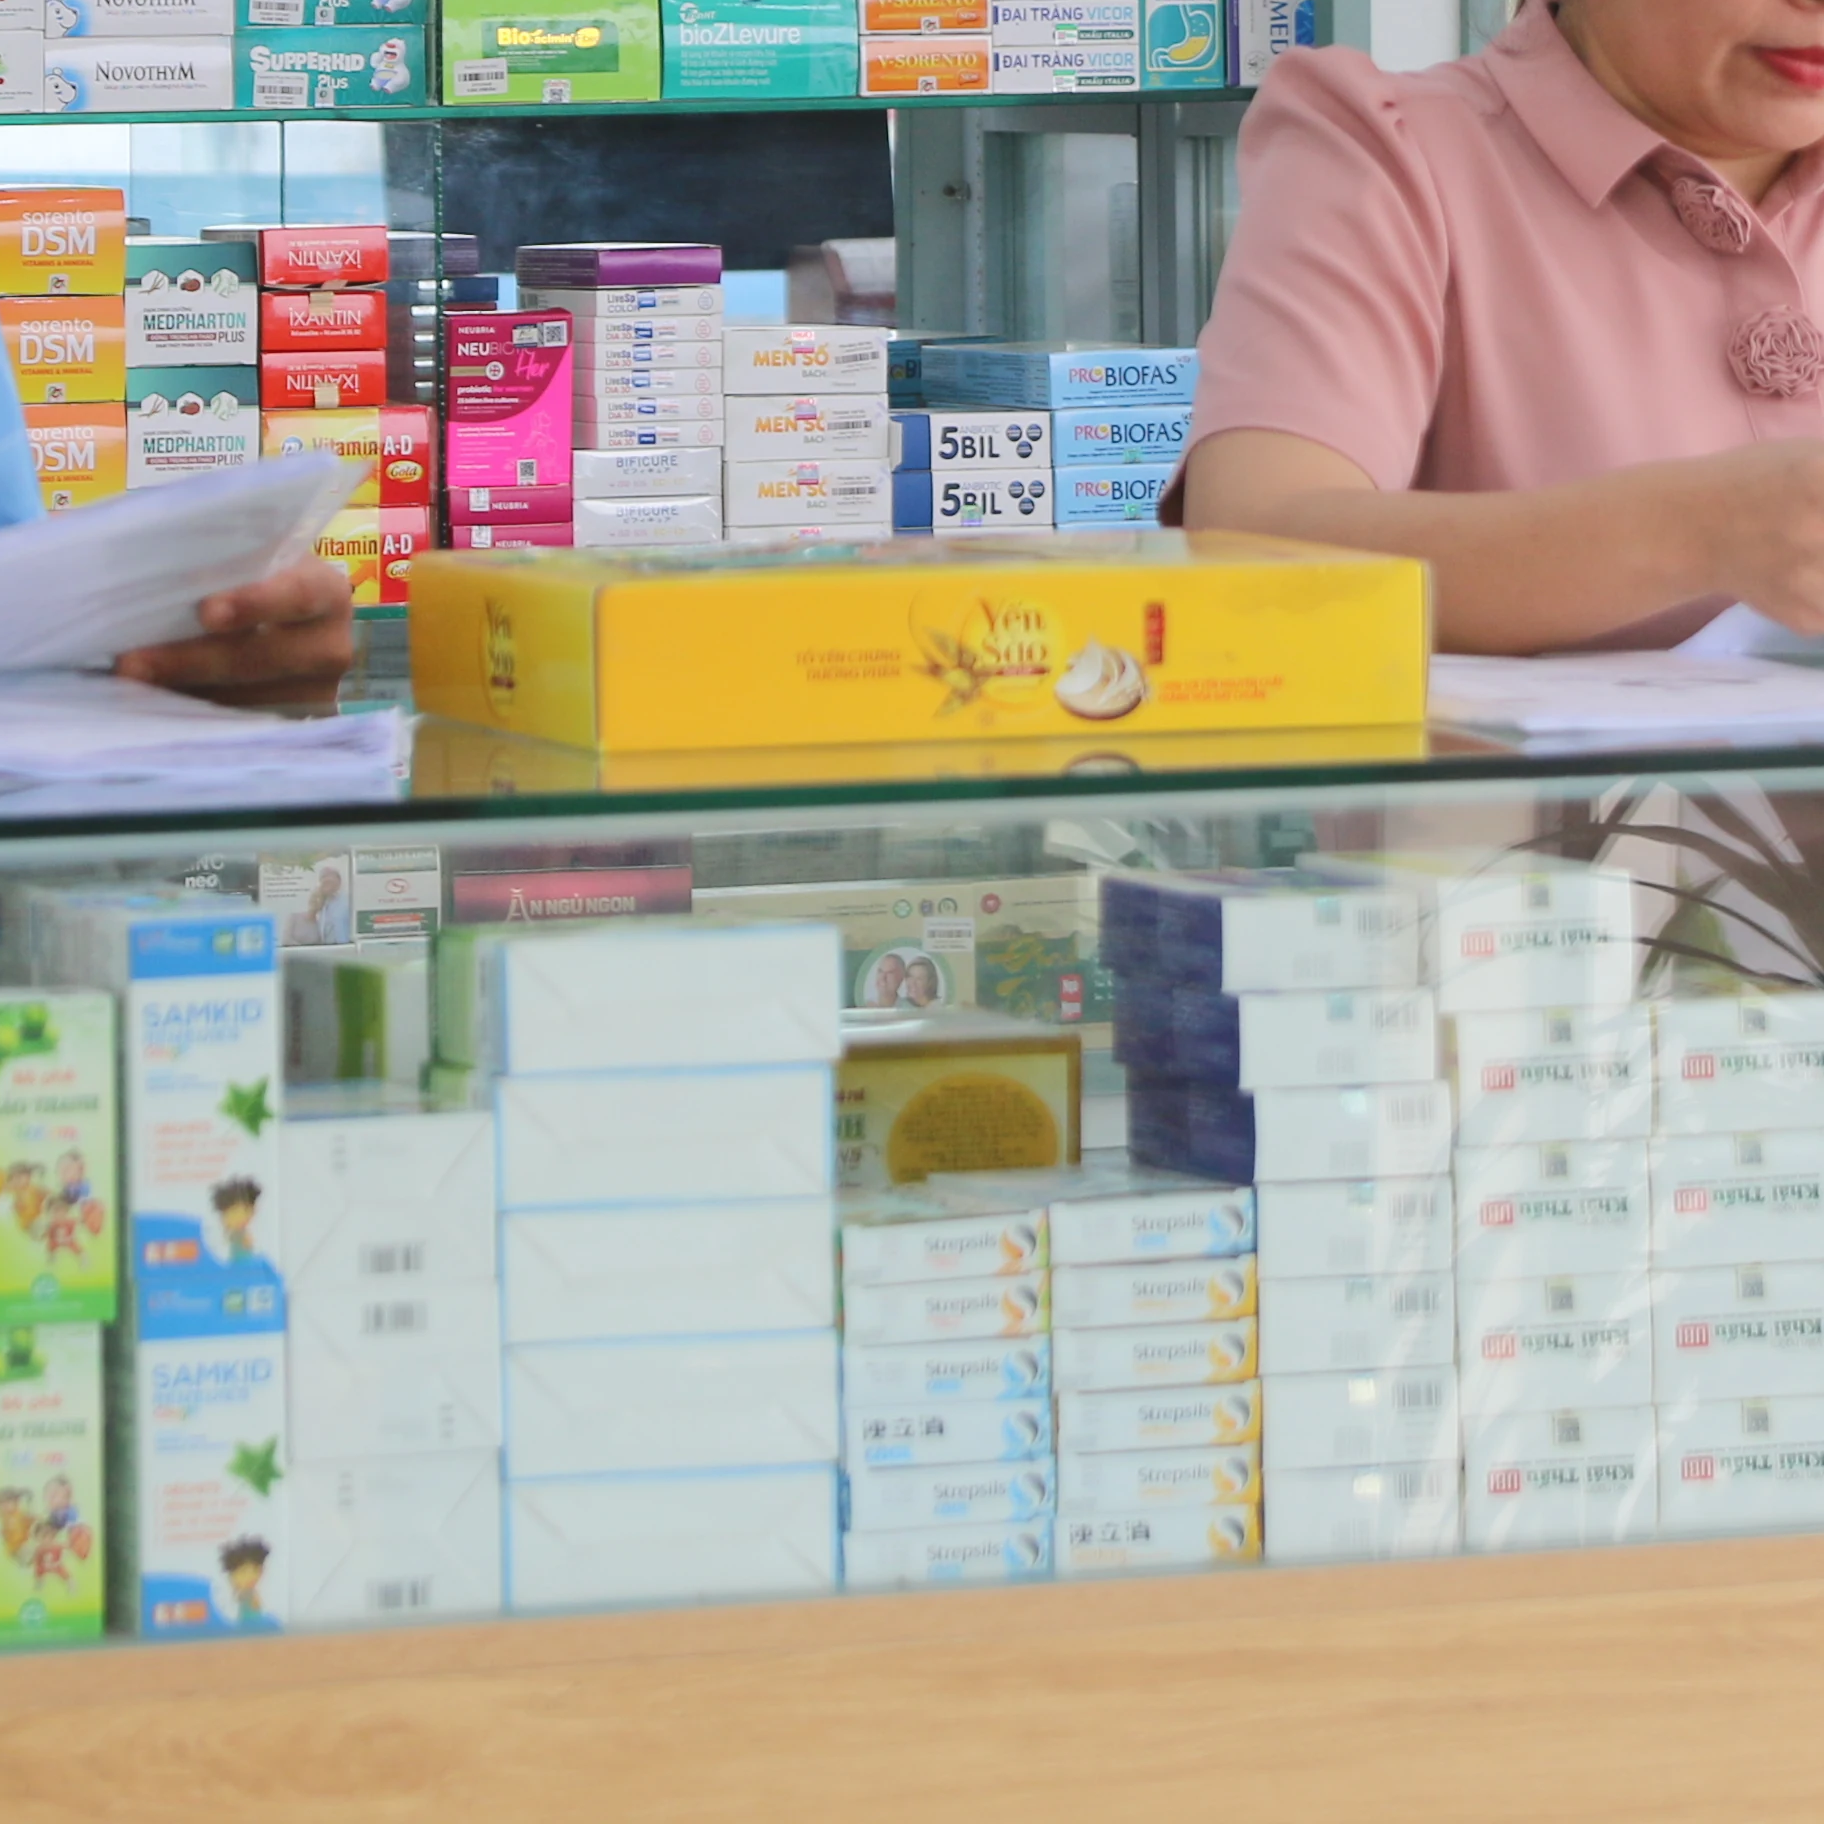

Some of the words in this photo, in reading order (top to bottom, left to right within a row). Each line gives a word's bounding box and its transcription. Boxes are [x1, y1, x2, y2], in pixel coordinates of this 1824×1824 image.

[22, 226, 95, 257] DSM
[20, 318, 93, 333] sorento
[143, 311, 247, 330] MEDPHARTON
[217, 330, 245, 343] PLUS
[755, 351, 787, 367] MEN
[389, 462, 419, 478] Gold
[616, 455, 679, 469] BIFICURE
[493, 501, 530, 511] NEUBRIA
[314, 535, 378, 555] Vitamin
[382, 532, 413, 554] A-D
[583, 895, 635, 914] NGON
[924, 1233, 999, 1252] Strepsils
